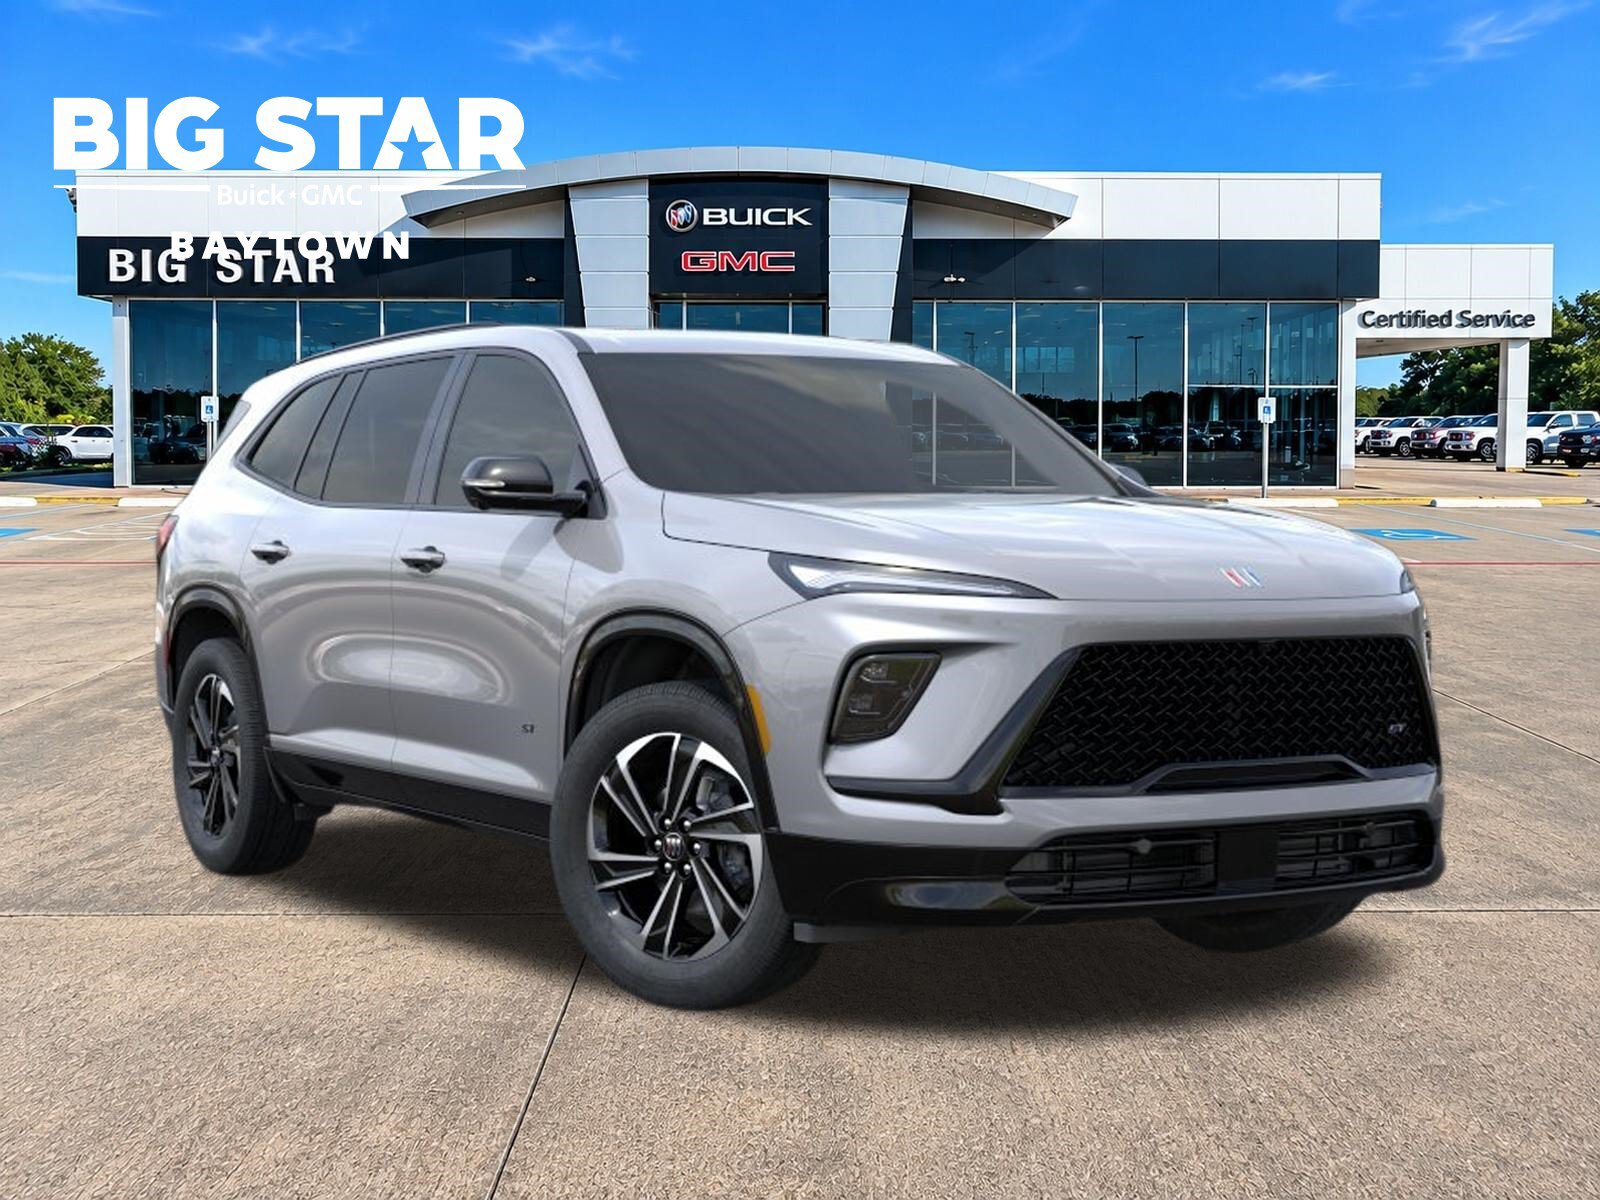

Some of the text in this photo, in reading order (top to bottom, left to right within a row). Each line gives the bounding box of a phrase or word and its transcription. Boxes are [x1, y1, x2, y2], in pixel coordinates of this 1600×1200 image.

[702, 207, 813, 226] BUICK
[108, 249, 187, 283] BIG
[681, 250, 796, 272] GMC
[1358, 309, 1536, 329] Certified Service
